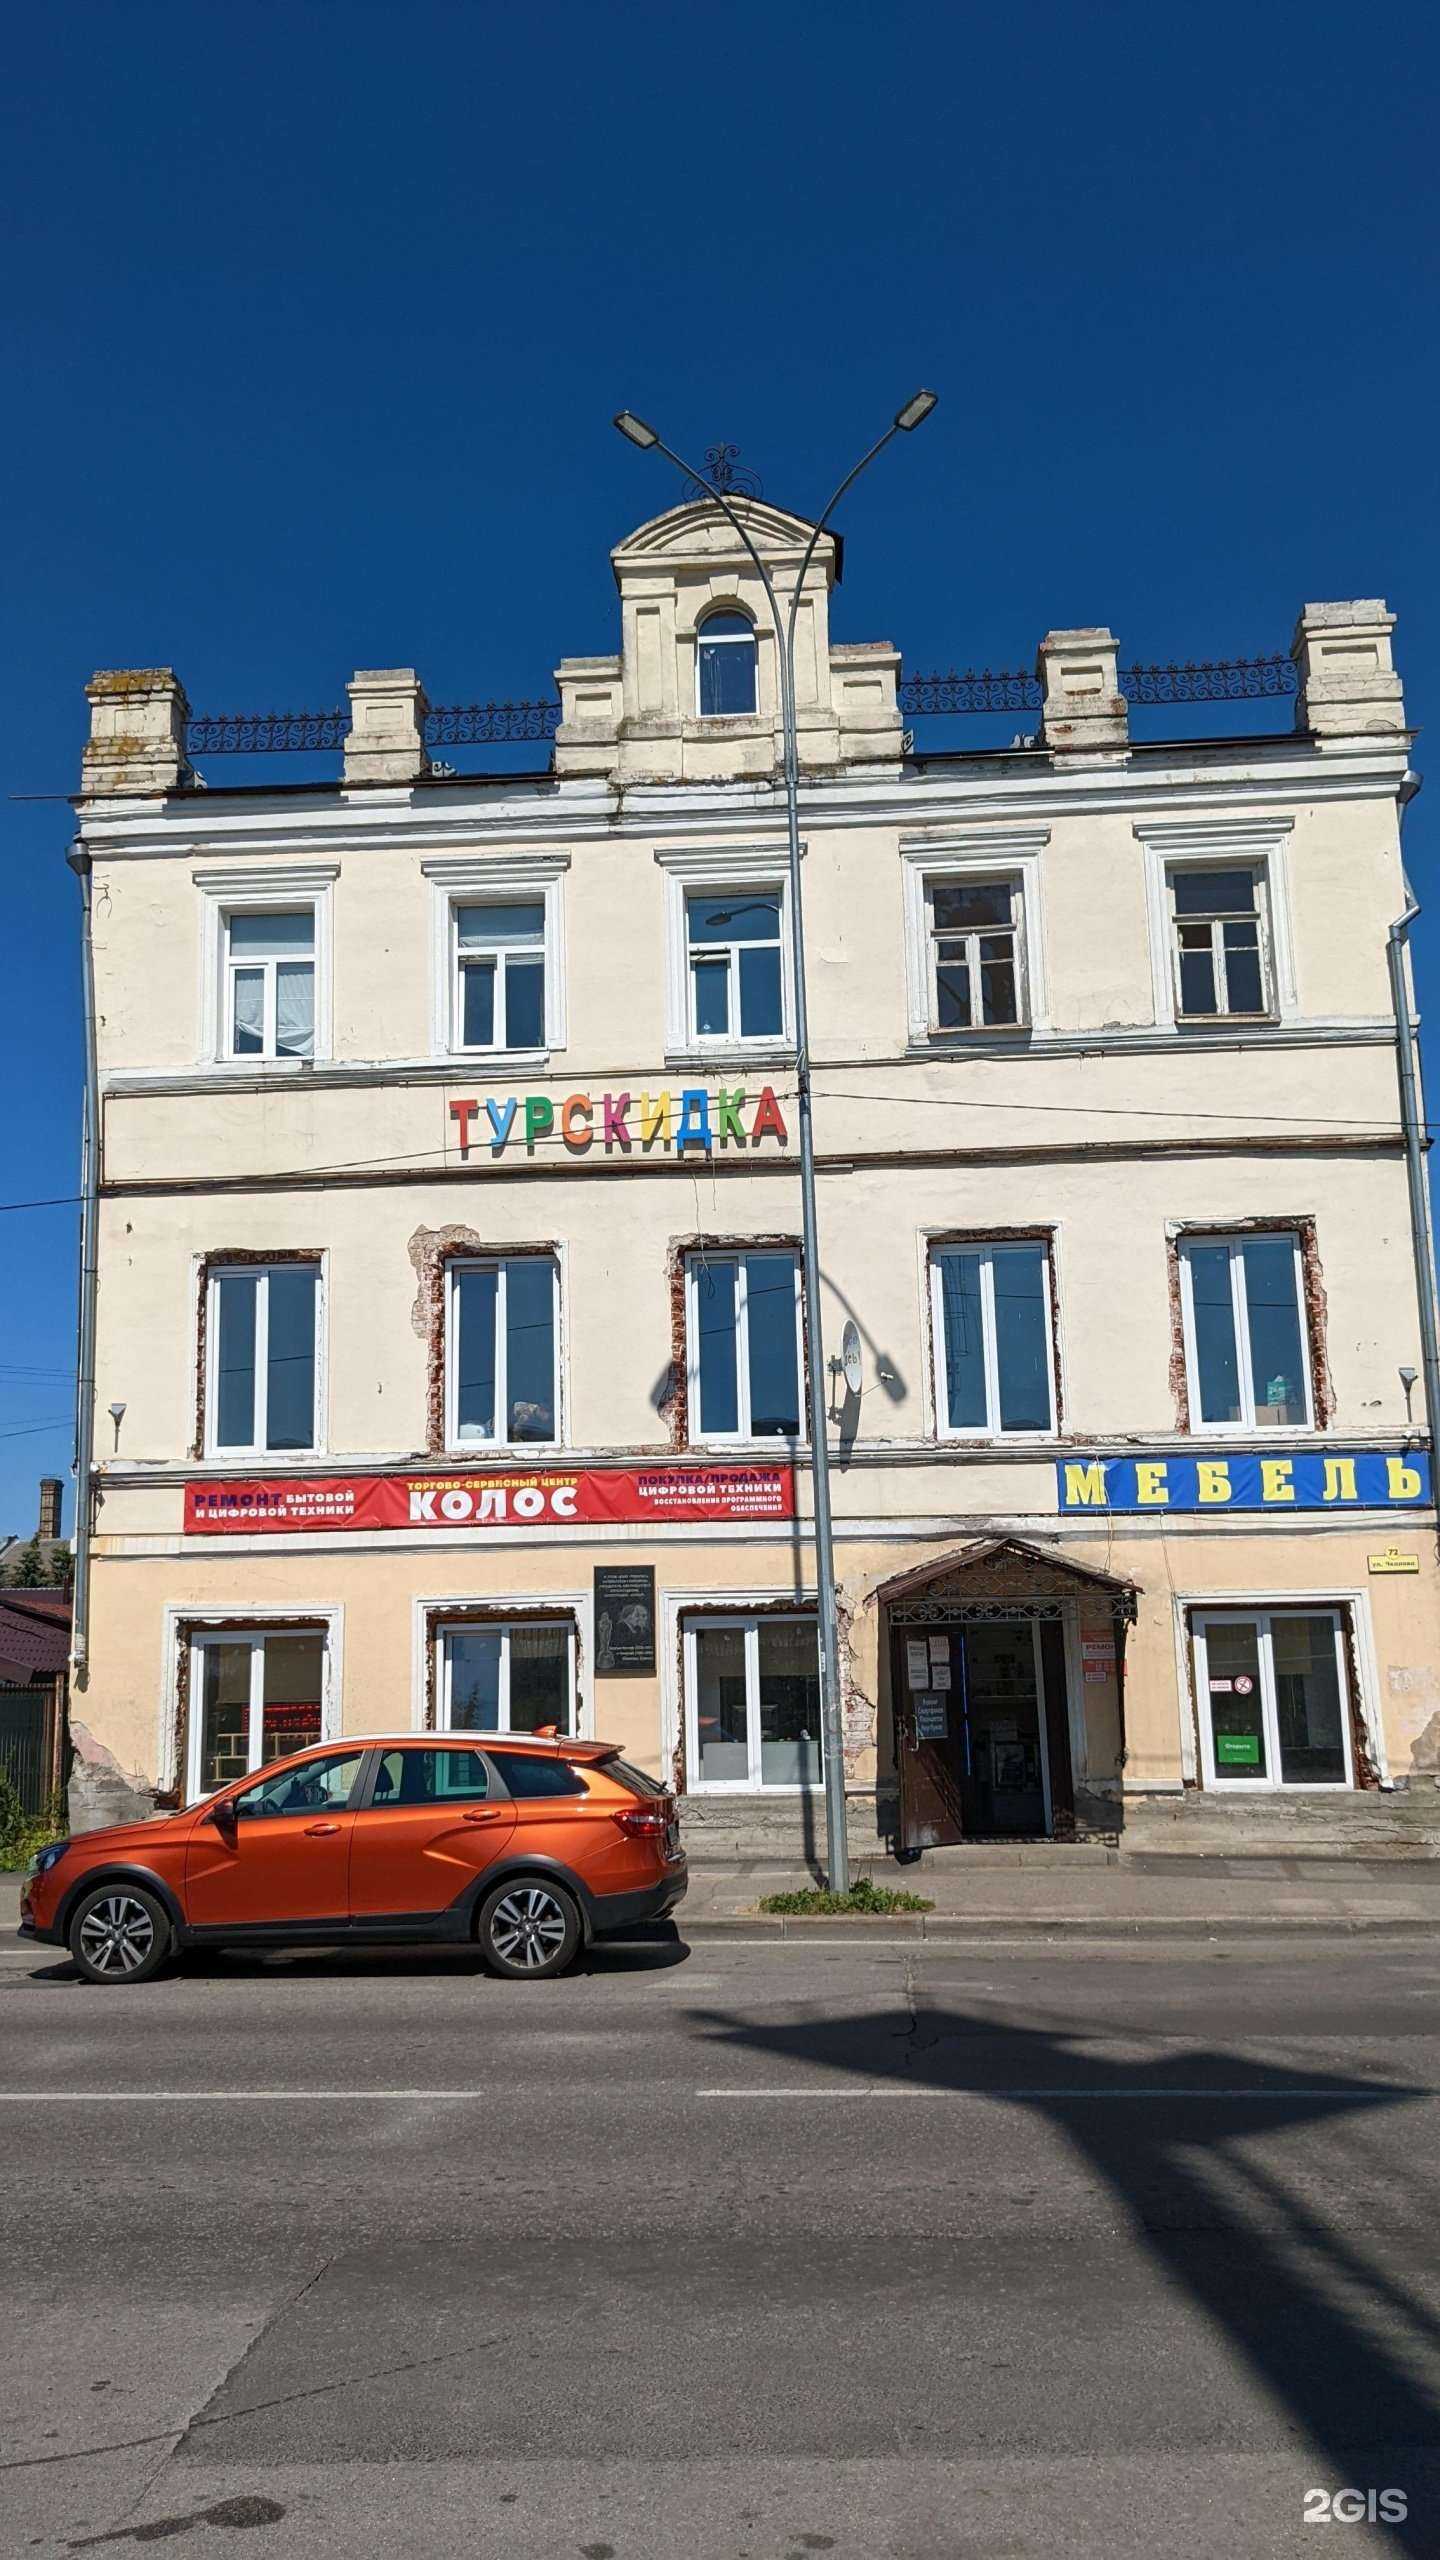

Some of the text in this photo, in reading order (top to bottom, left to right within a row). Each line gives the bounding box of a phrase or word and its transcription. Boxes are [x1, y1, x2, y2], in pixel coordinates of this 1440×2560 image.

[449, 1086, 788, 1150] ТУРСКИДКА
[407, 1476, 578, 1491] ТОРГОВО-СЕРВИСНЫЙ ЦЕНТР
[638, 1472, 781, 1485] ПОКУПКА/ПРОДАЖА
[1063, 1457, 1422, 1505] МЕБЕЛЬ
[639, 1482, 782, 1496] ЦИФРОВОЙ ТЕХНИКИ
[194, 1490, 354, 1507] РЕМОНТ БЫТОВОЙ
[409, 1486, 578, 1521] КОЛОС
[195, 1505, 354, 1520] И ЦИФРОВОЙ ТЕХНИКИ
[1387, 1548, 1398, 1556] 72
